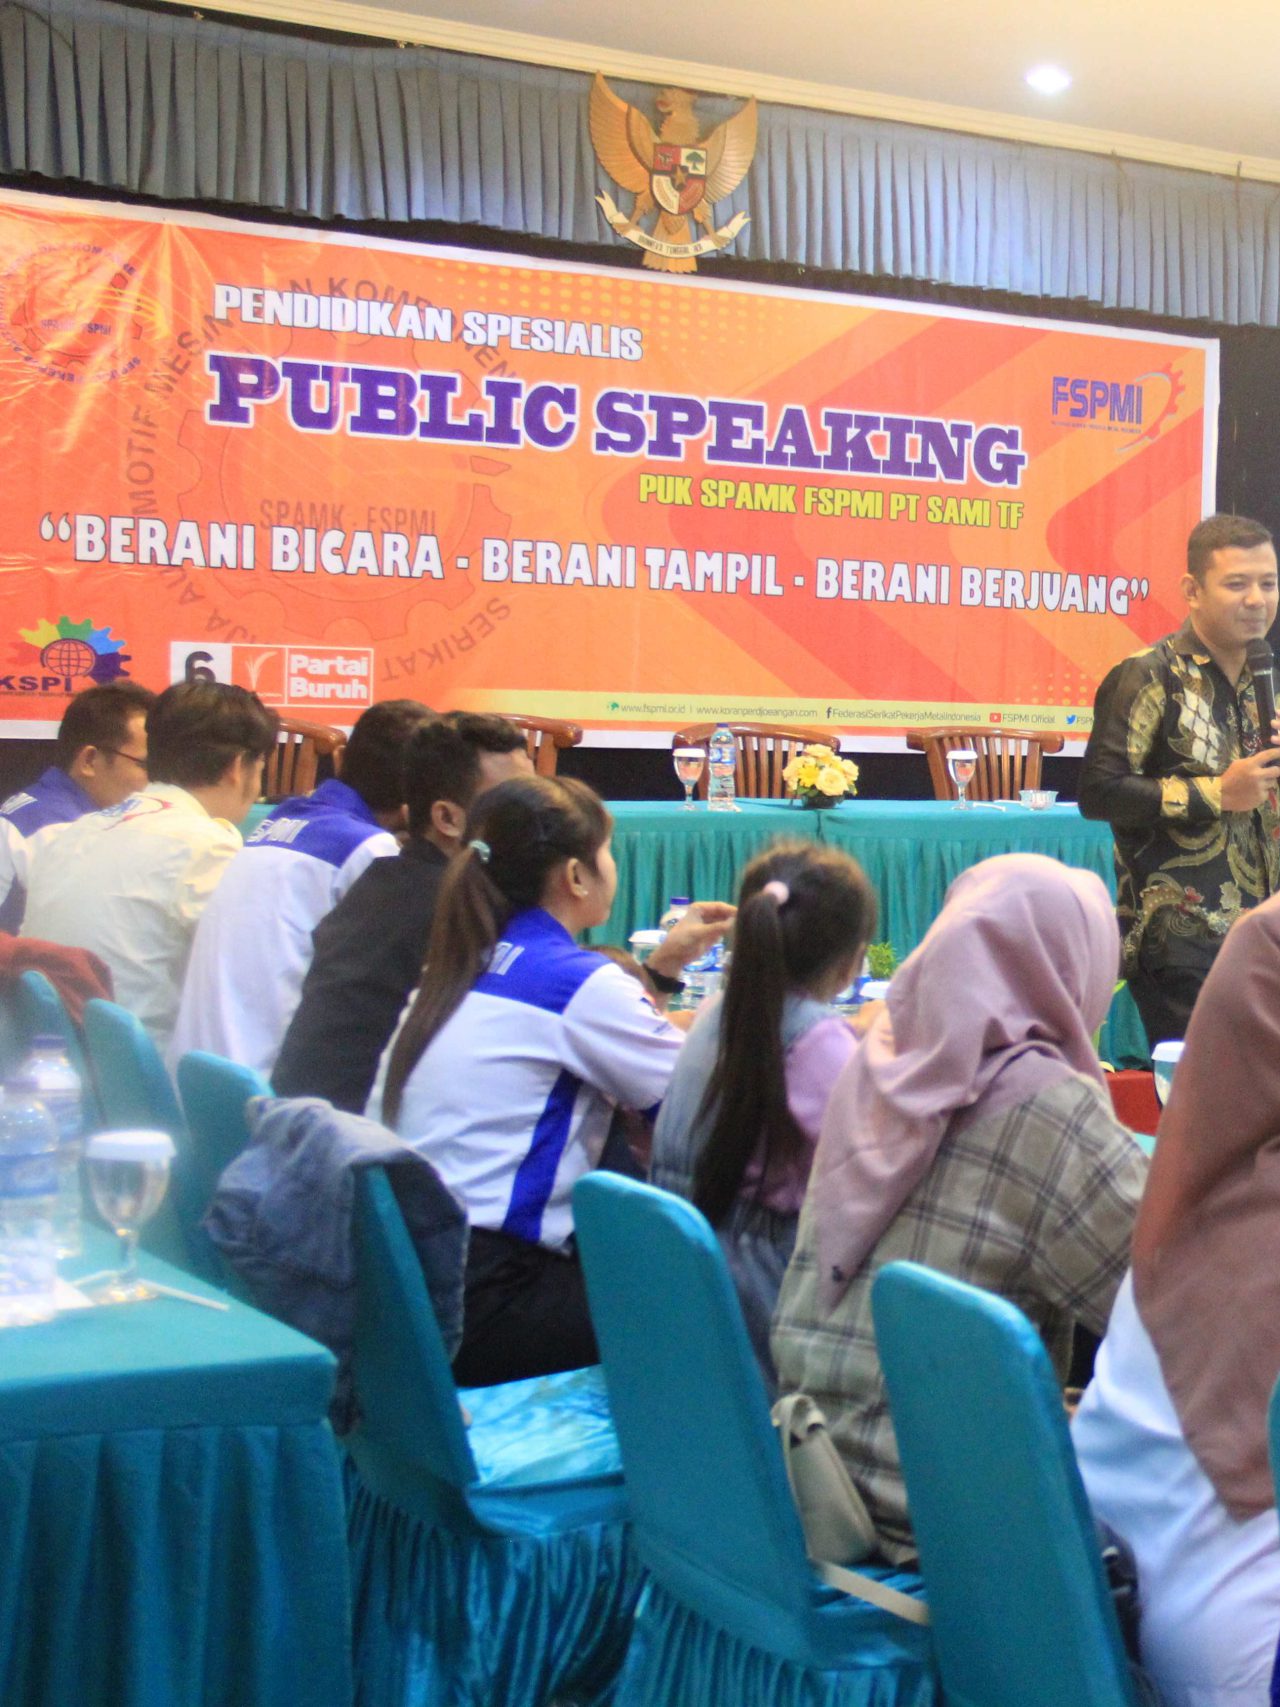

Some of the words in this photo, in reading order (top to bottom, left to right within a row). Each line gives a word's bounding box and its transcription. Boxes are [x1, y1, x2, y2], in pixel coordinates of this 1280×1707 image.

[214, 283, 453, 342] PENDIDIKAN
[462, 311, 643, 361] SPESIALIS
[206, 352, 579, 449] PUBLIC
[594, 390, 1027, 486] SPEAKING
[1052, 376, 1143, 424] FSPMI
[639, 473, 693, 506] PUK
[700, 479, 797, 513] SPAMK
[803, 486, 883, 520] FSPMI
[889, 492, 920, 522] PT
[927, 495, 992, 527] SAMI
[997, 501, 1025, 529] TF
[271, 525, 445, 579] BICARA
[482, 537, 636, 588] BERANI
[645, 547, 784, 596] TAMPIL
[816, 557, 950, 605] BERANI
[0, 675, 72, 692] KSPI
[185, 651, 216, 683] 6
[290, 654, 368, 676] Partai
[290, 677, 368, 699] Buruh
